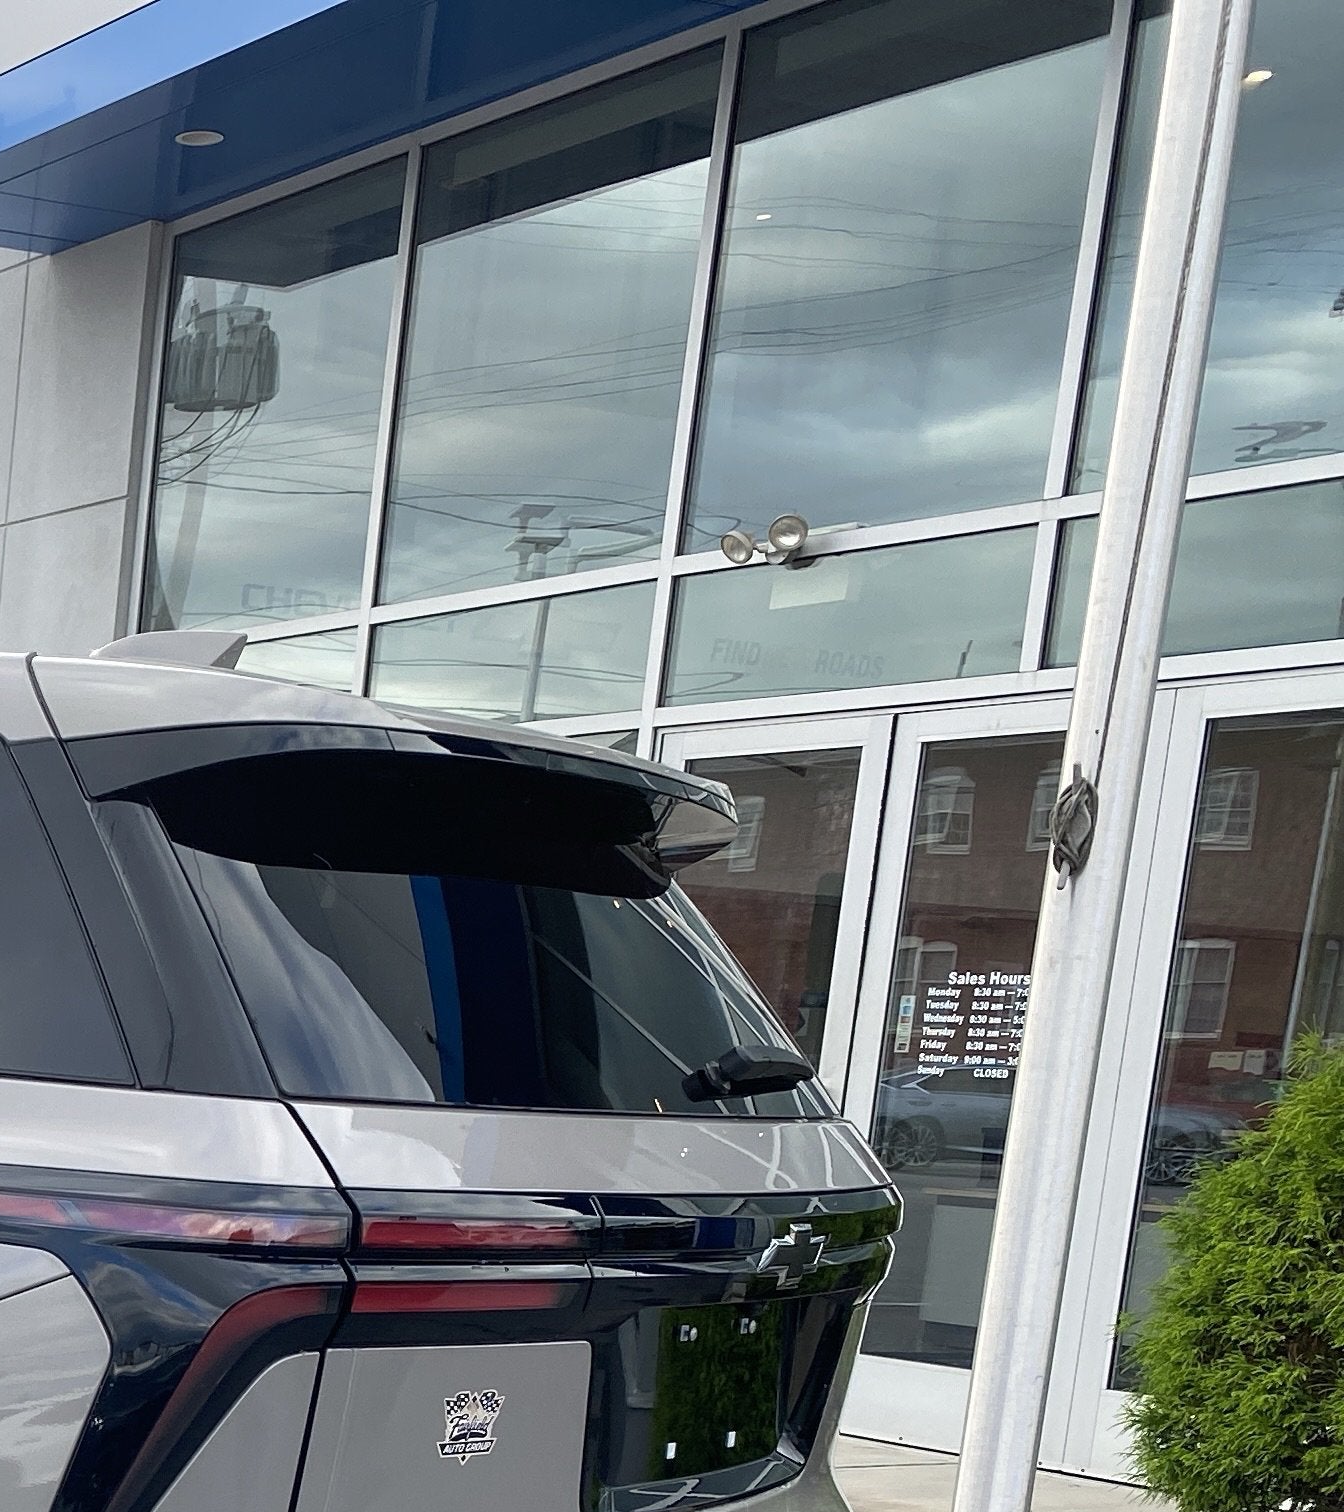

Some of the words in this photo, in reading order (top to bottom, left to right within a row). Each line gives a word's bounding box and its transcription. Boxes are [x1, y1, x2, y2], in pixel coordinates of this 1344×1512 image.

[947, 971, 986, 985] Sales
[989, 971, 1031, 985] Hours
[927, 987, 962, 999] Monday
[926, 999, 960, 1012] Tuesday
[923, 1012, 965, 1026] Wednesday
[922, 1026, 956, 1039] Thursday
[920, 1039, 947, 1052] Friday
[918, 1052, 959, 1065] Saturday
[917, 1064, 945, 1078] Sunday
[973, 1068, 1009, 1079] CLOSED
[443, 1443, 465, 1454] AUTO
[465, 1441, 492, 1452] GROUP
